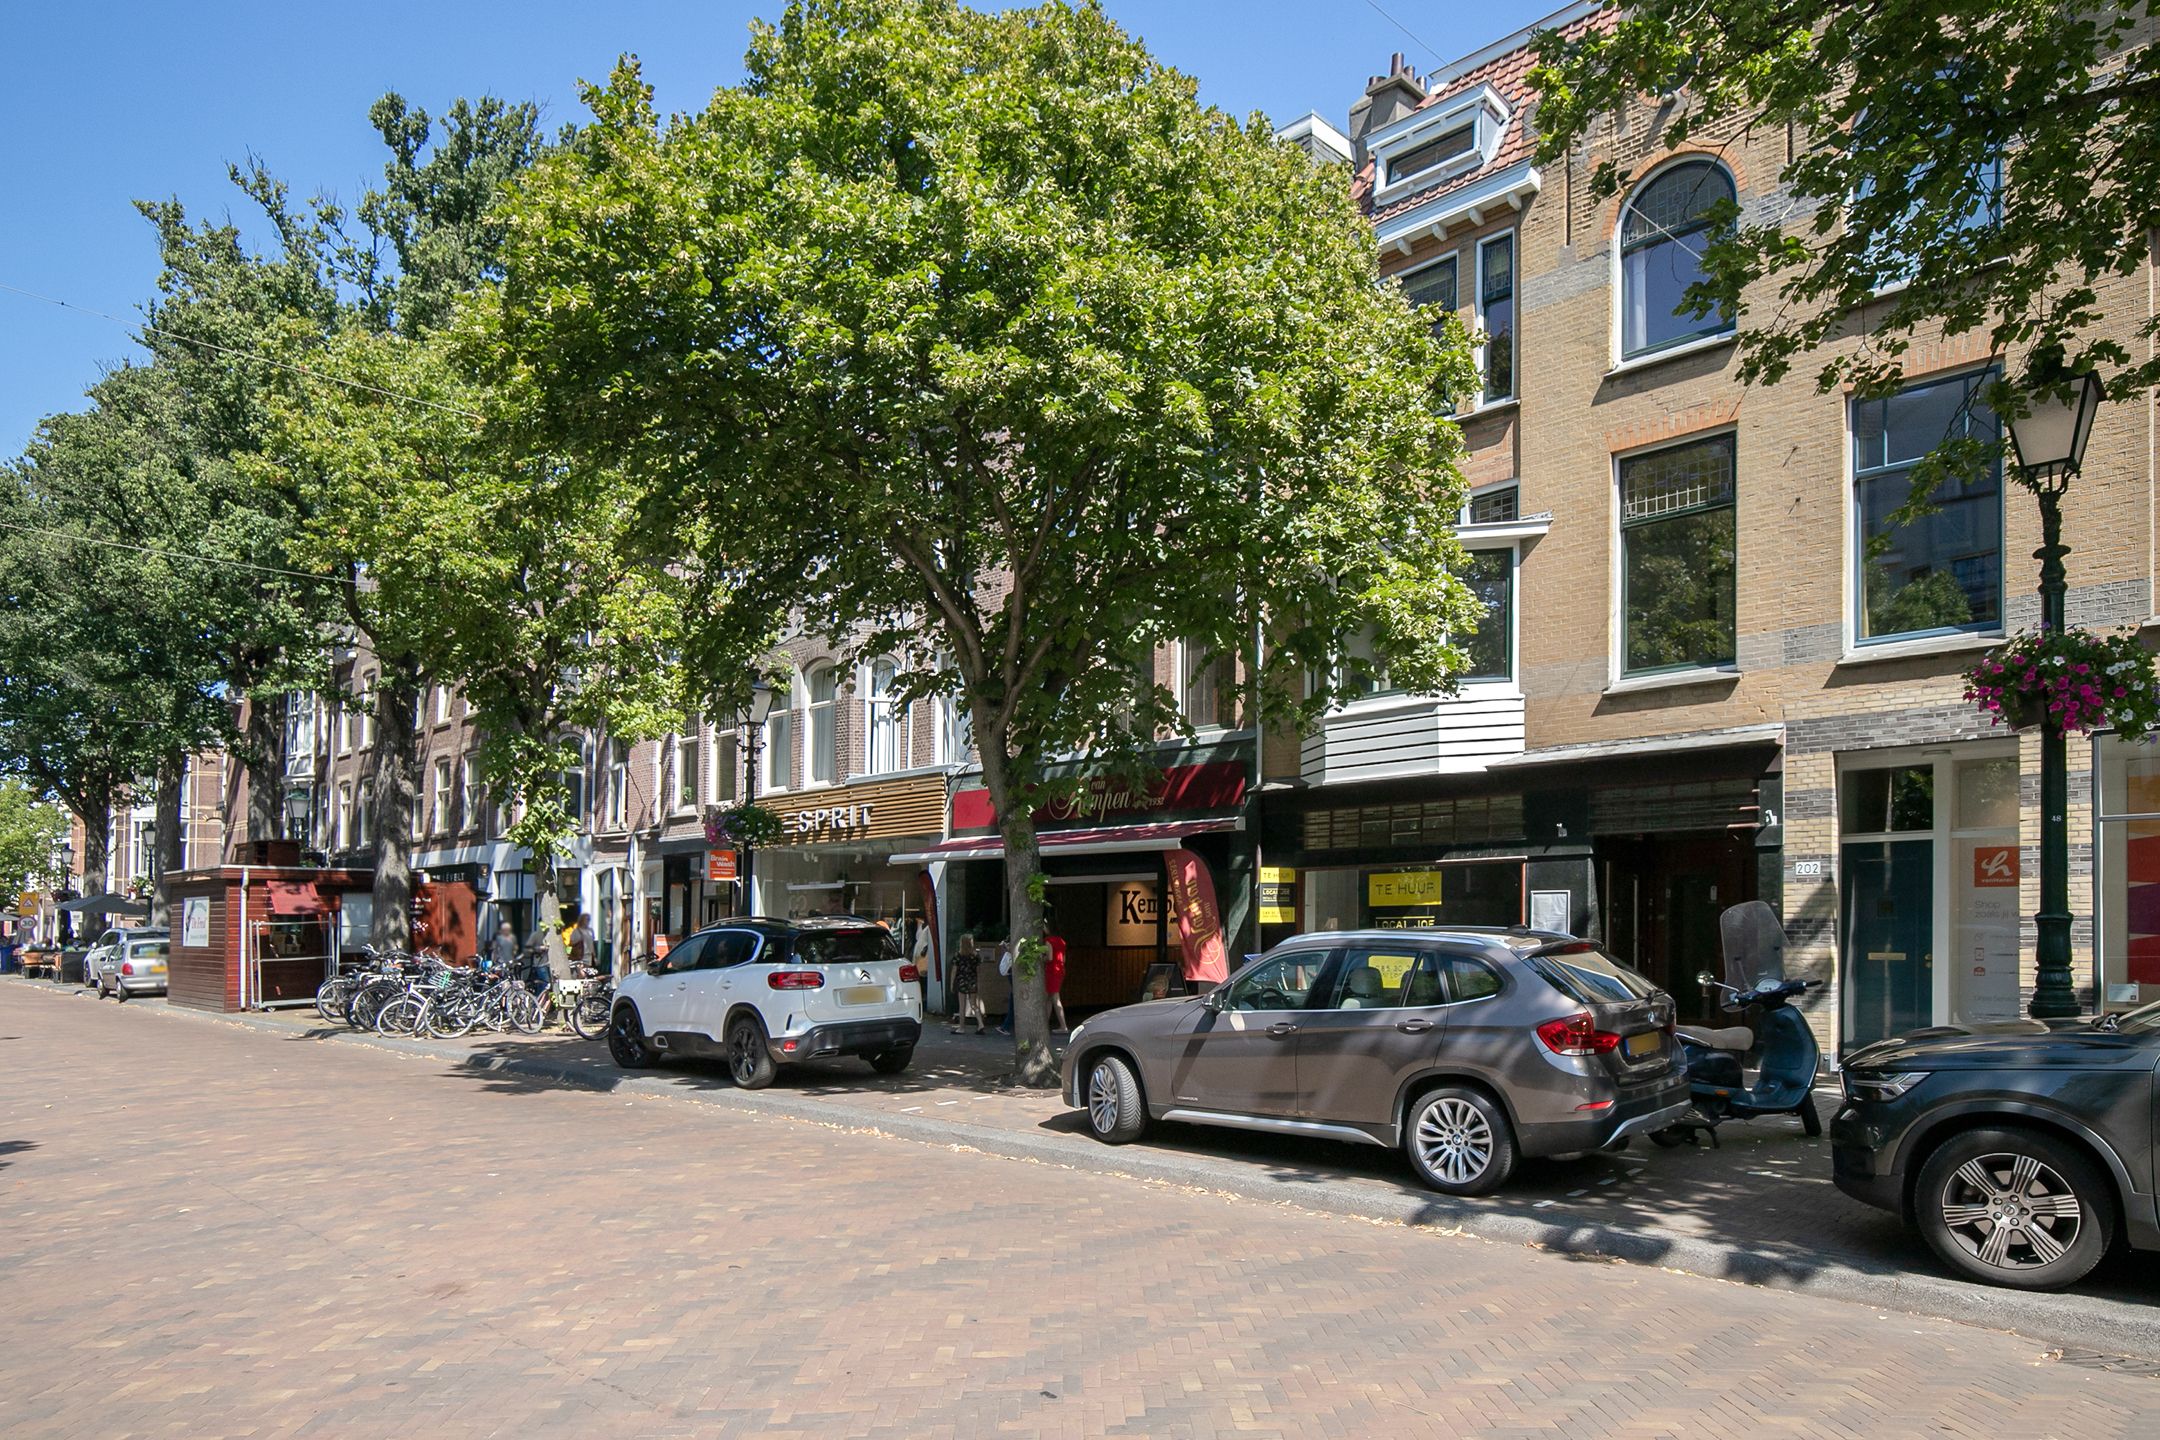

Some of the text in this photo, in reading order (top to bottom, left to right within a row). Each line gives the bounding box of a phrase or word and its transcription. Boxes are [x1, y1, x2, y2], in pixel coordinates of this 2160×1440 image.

[783, 803, 875, 833] ESPRIT
[710, 854, 729, 862] Brain
[716, 860, 736, 868] Wash
[1797, 863, 1819, 874] 202
[1375, 881, 1437, 896] TE HUUR
[22, 919, 33, 927] 30
